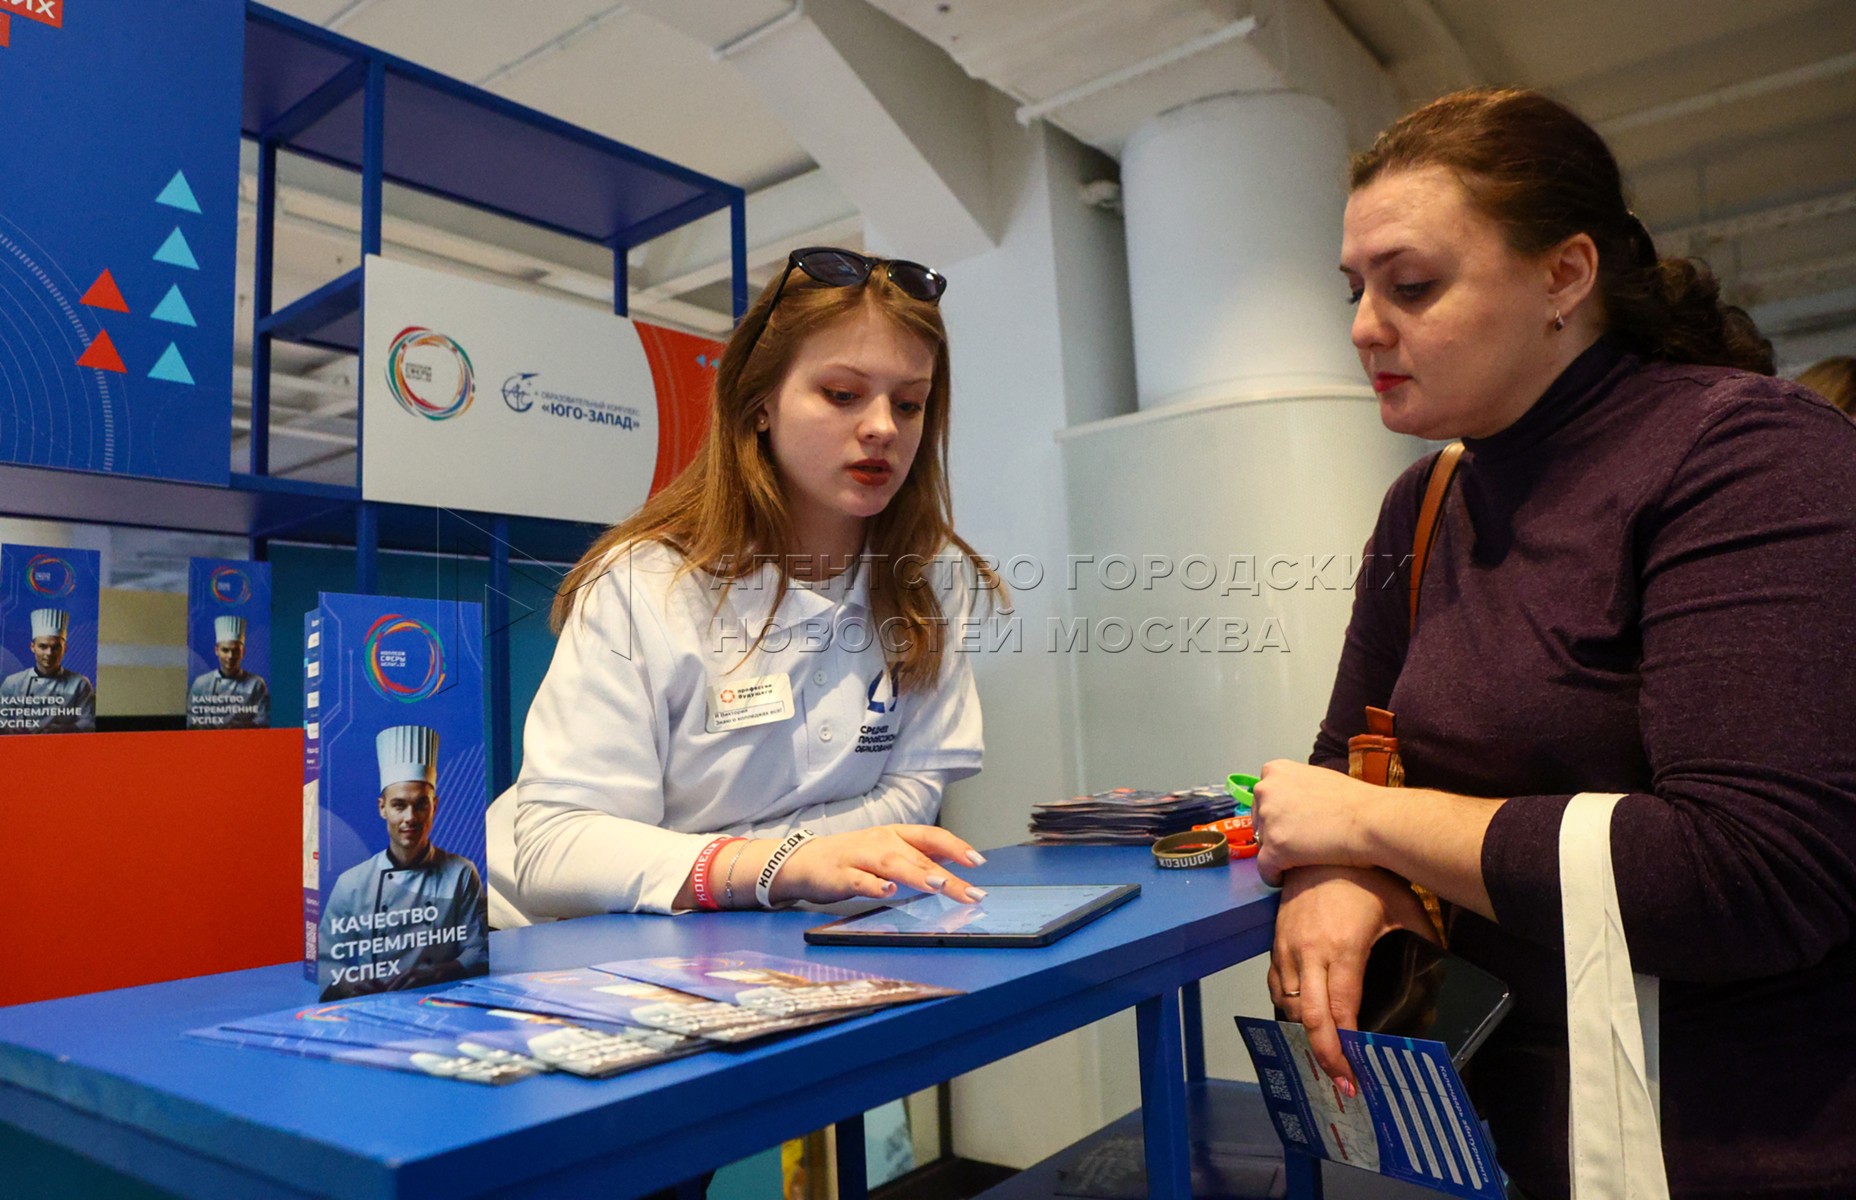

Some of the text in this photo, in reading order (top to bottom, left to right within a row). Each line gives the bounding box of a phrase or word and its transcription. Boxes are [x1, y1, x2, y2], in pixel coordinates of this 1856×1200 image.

[541, 402, 640, 431] «ЮГО-ЗАПАД»
[1, 695, 65, 705] КАЧЕСТВО
[191, 694, 245, 704] КАЧЕСТВО
[0, 706, 82, 717] СТРЕМЛЕНИЕ
[191, 704, 260, 715] СТРЕМЛЕНИЕ
[0, 718, 40, 729] УСПЕХ
[191, 715, 224, 725] УСПЕХ
[758, 832, 805, 889] КОЛЛЕДЖ
[1158, 851, 1214, 868] КОЛЛЕДЖ
[331, 905, 439, 935] КАЧЕСТВО
[330, 925, 468, 960] СТРЕМЛЕНИЕ
[330, 959, 401, 986] УСПЕХ
[1439, 1065, 1463, 1118] Календарь
[1461, 1119, 1490, 1184] абитуриента
